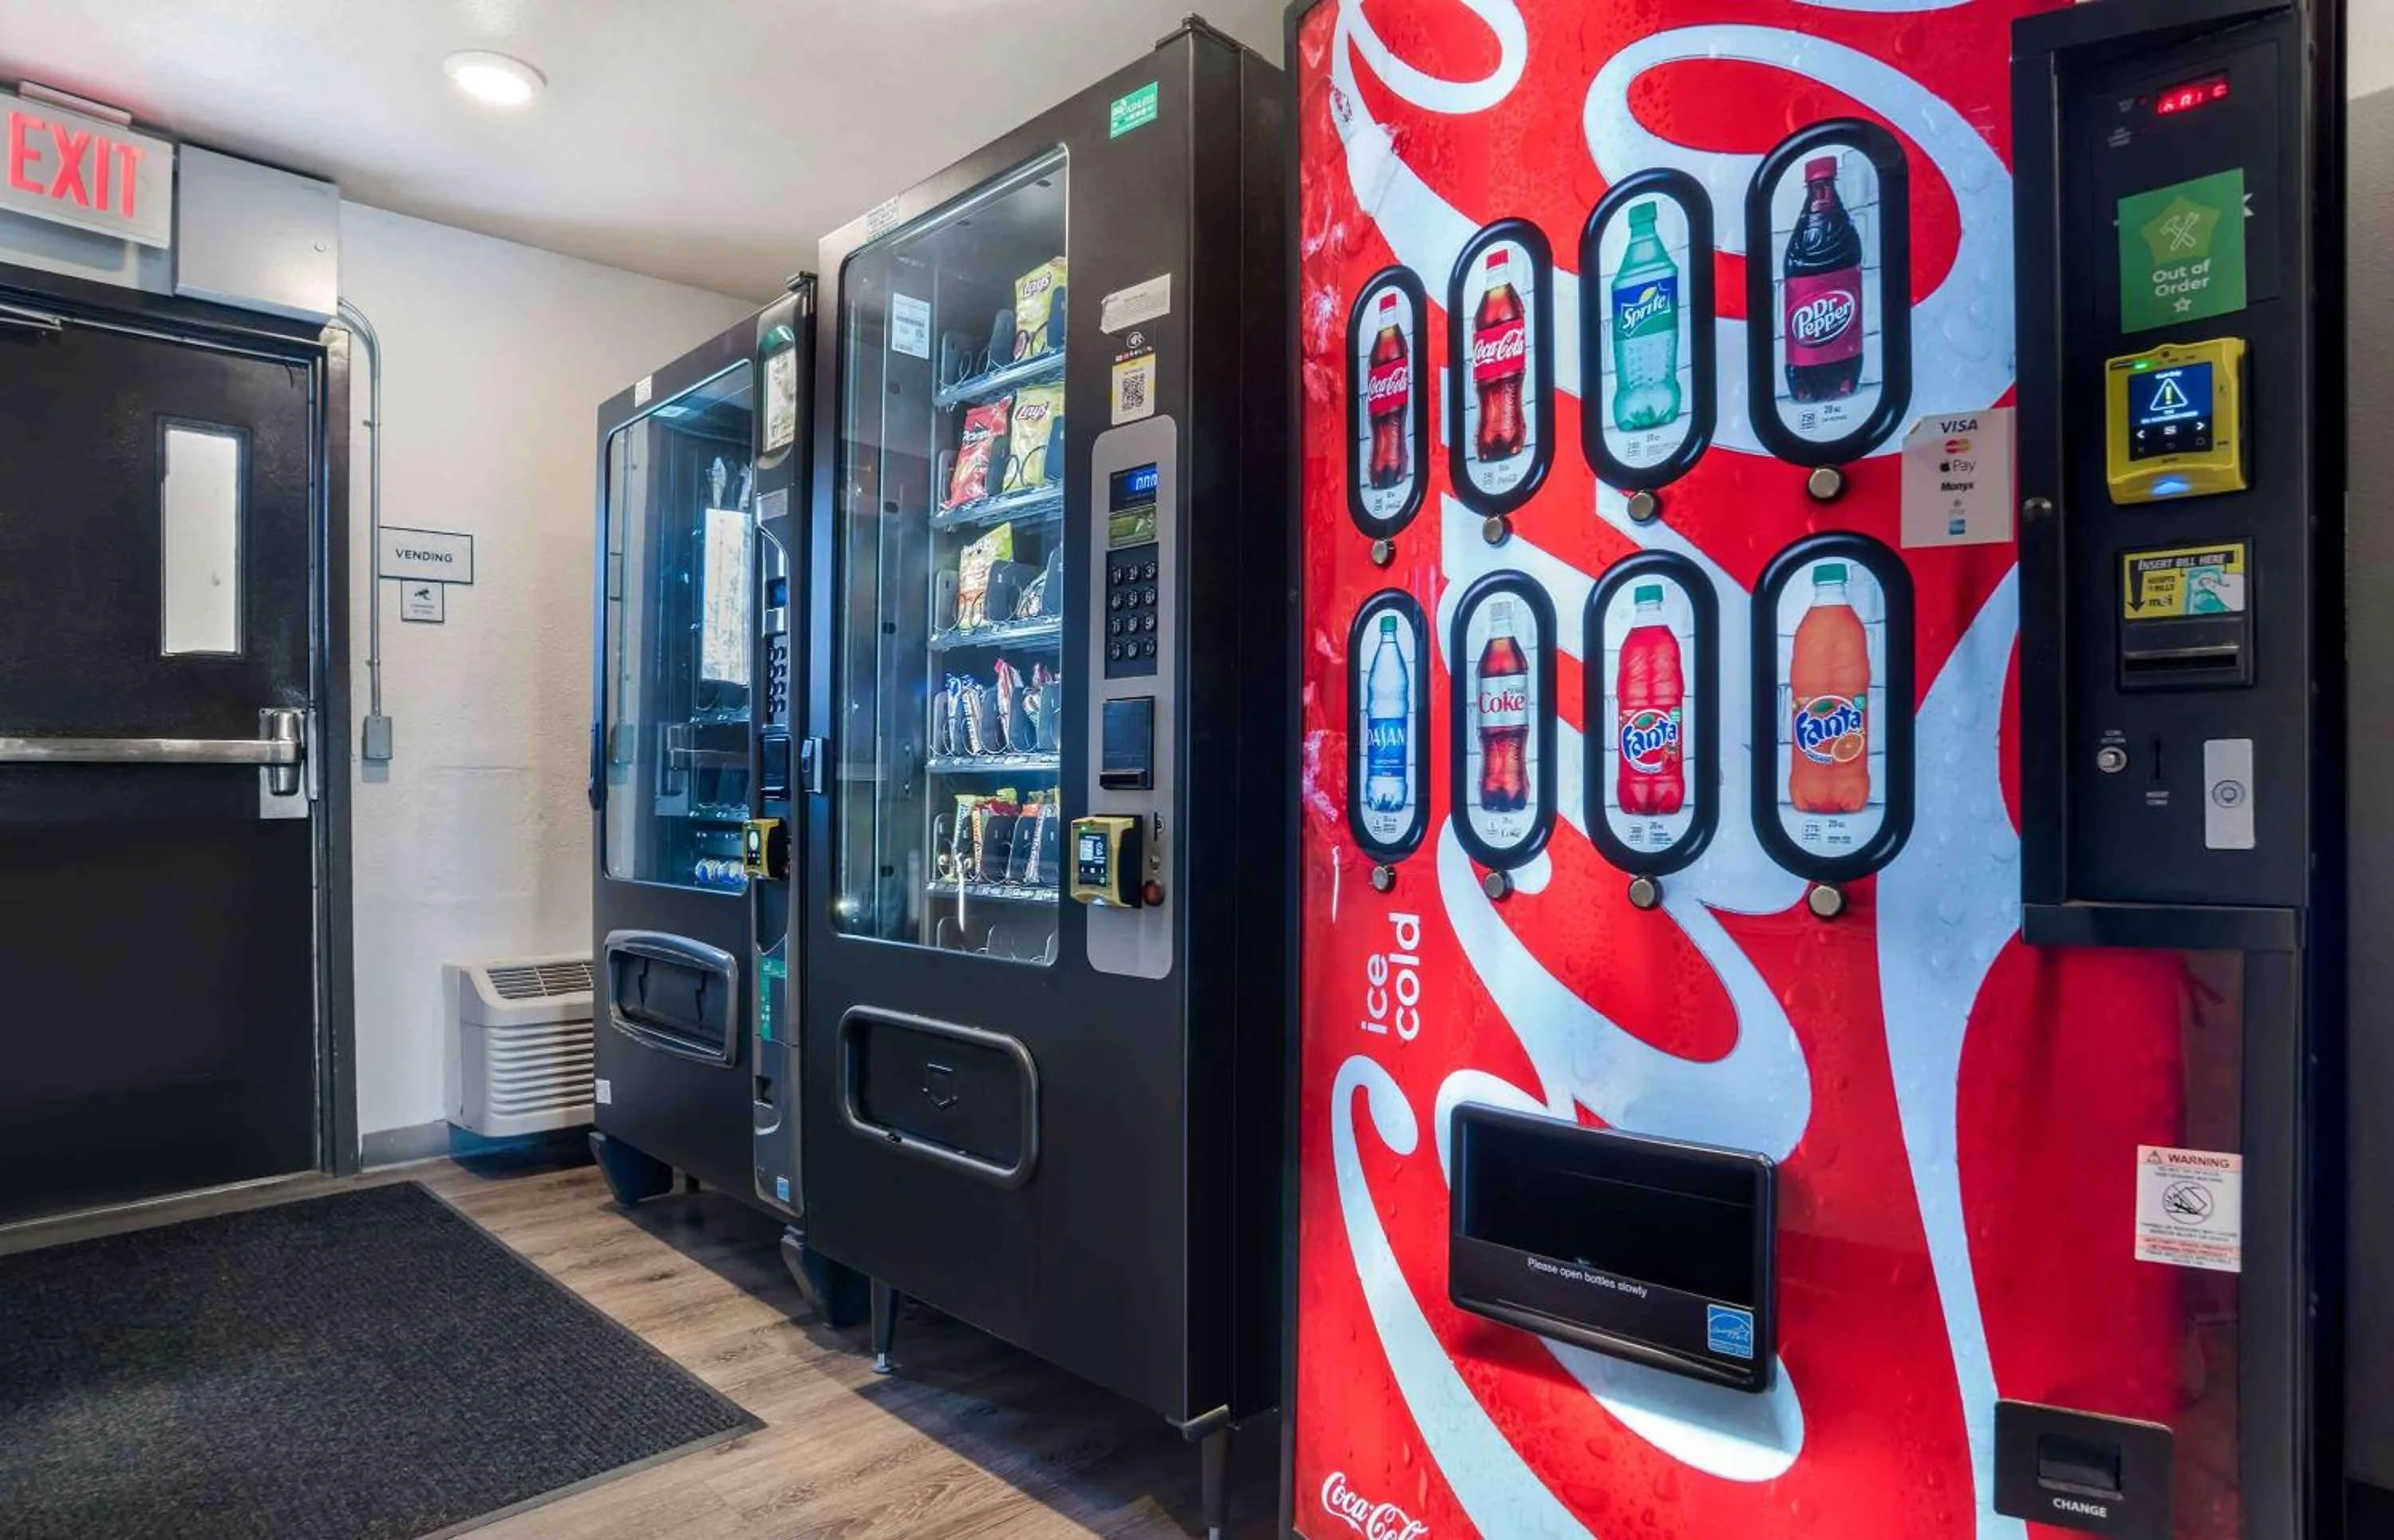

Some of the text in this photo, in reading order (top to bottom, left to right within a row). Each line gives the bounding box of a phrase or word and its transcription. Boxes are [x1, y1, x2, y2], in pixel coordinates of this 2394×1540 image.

[8, 111, 146, 219] EXIT
[2153, 259, 2211, 283] Out of
[2155, 278, 2210, 298] Order
[1622, 292, 1666, 330] Sprite
[1793, 302, 1851, 339] Pepper
[1813, 298, 1837, 319] Dr
[1473, 329, 1525, 365] Coca-Cola
[1368, 366, 1408, 401] Coca-Cola
[1941, 419, 1978, 433] VISA
[1953, 459, 1976, 475] Pay
[395, 548, 453, 563] VENDING
[2138, 552, 2226, 571] INSERT BILL HERE
[1479, 691, 1525, 714] Coke
[1622, 718, 1677, 762] Fanta
[1795, 705, 1862, 751] Fanta
[1389, 912, 1420, 1041] cold
[1361, 954, 1389, 1035] ice
[2167, 1154, 2230, 1169] WARNING
[1527, 1257, 1648, 1299] Please open bottles slowly
[2052, 1498, 2108, 1518] CHANGE
